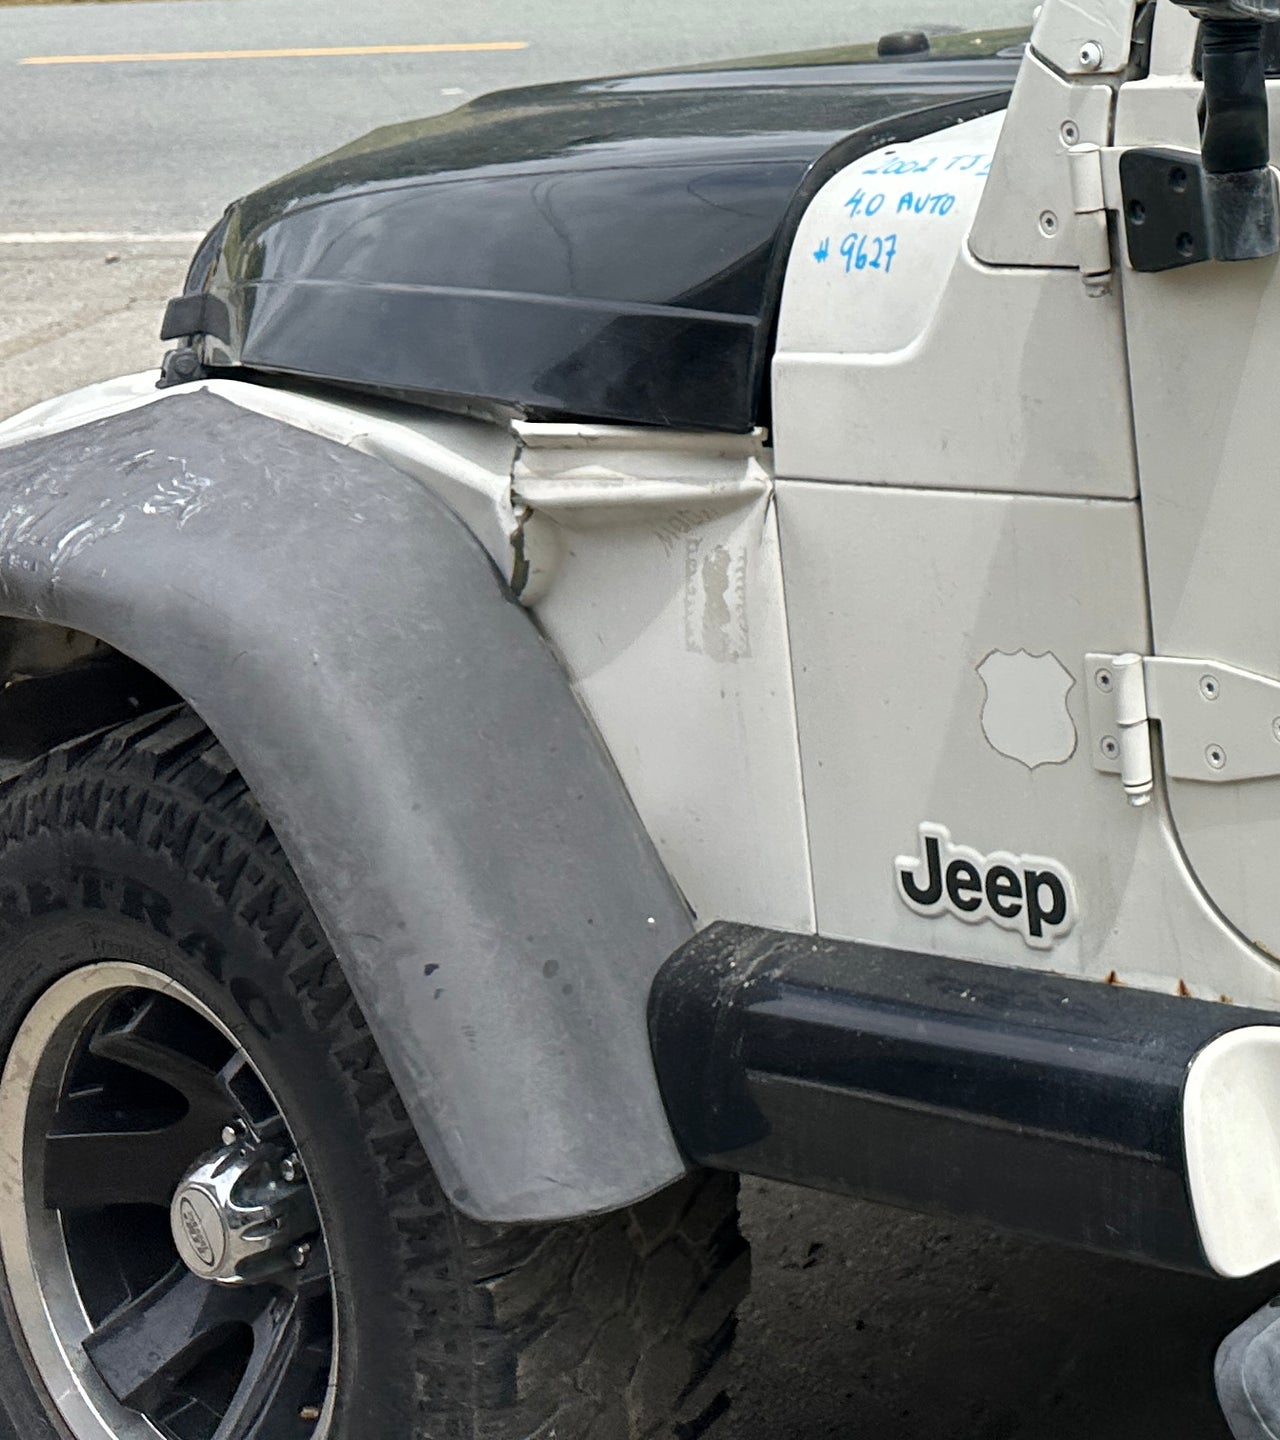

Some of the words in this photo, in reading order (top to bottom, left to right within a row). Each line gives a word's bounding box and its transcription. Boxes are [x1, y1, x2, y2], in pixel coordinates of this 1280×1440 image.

[862, 156, 935, 174] 2002
[844, 188, 885, 218] 4.0
[896, 191, 956, 216] AUTO
[840, 233, 897, 273] 9627
[900, 835, 1068, 939] Jeep
